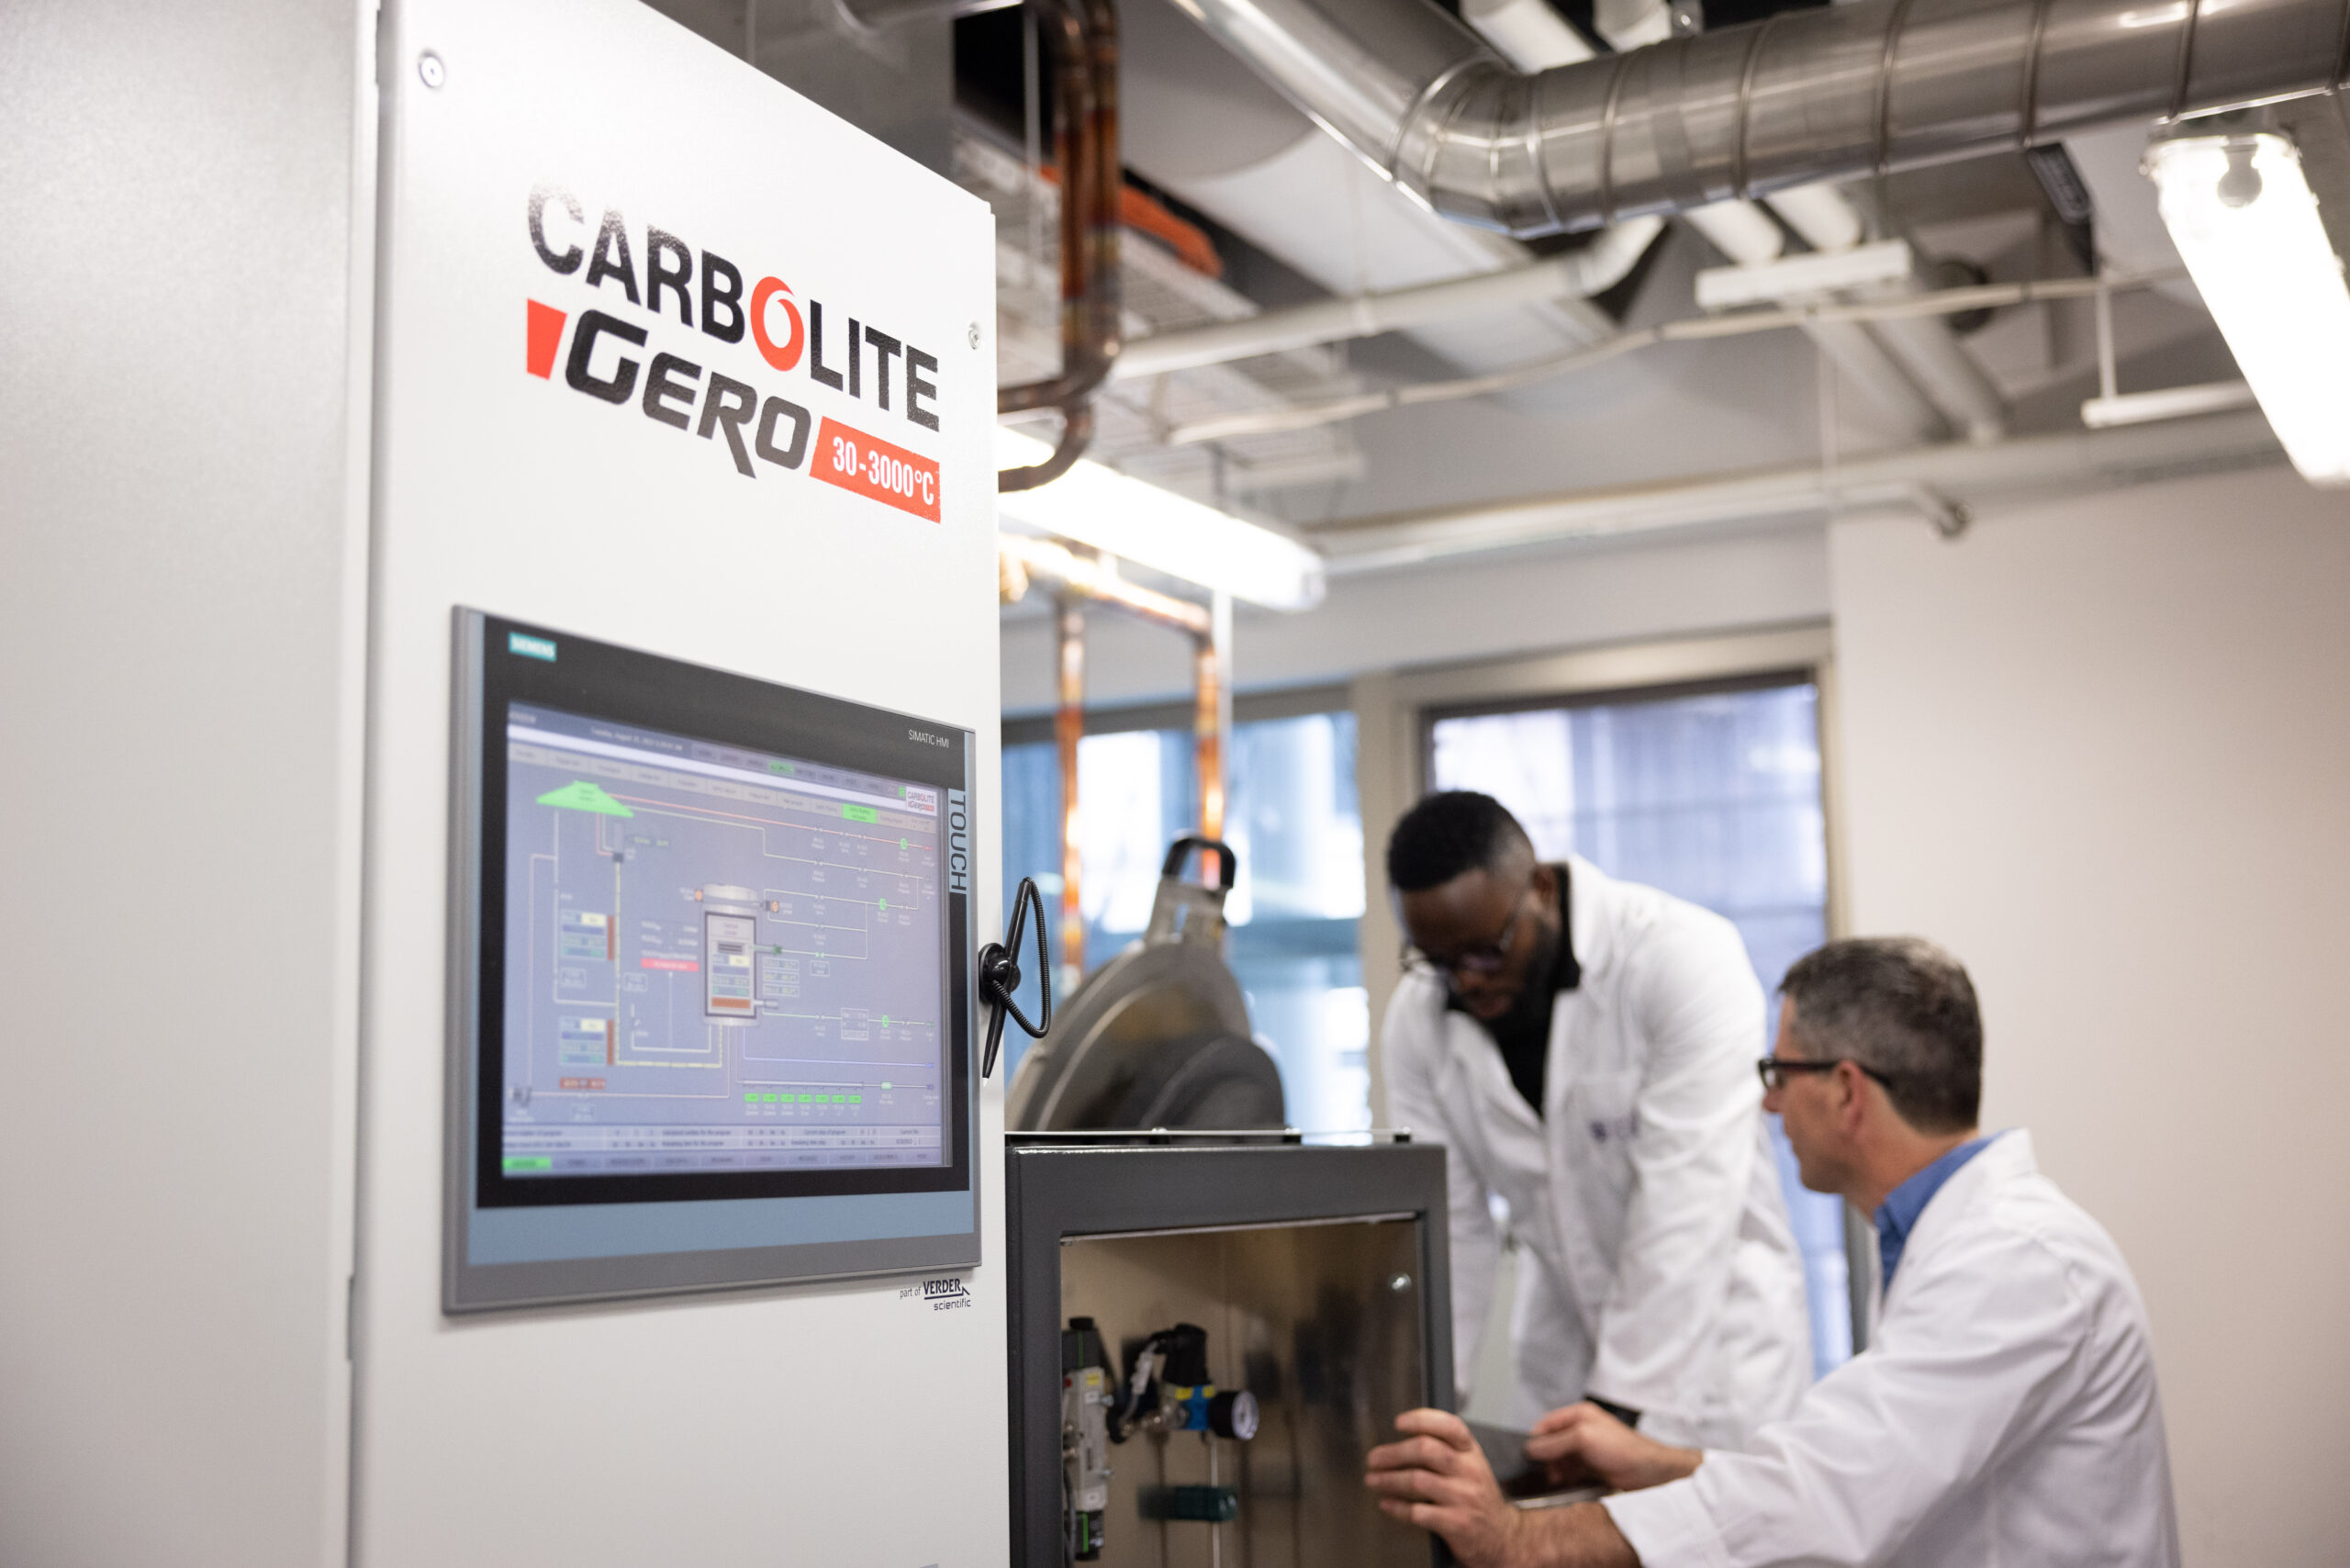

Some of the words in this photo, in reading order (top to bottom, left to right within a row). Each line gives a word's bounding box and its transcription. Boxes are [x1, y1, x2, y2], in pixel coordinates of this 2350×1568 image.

[527, 182, 940, 433] CARBOLITE
[565, 309, 811, 479] GERO
[833, 436, 934, 506] 30-3000°C
[908, 729, 935, 745] SIMATIC
[936, 736, 950, 748] HMI
[950, 794, 967, 891] TOUCH
[900, 1287, 912, 1301] part
[914, 1286, 922, 1296] of
[923, 1278, 961, 1295] VERDER
[934, 1298, 971, 1311] scientific
